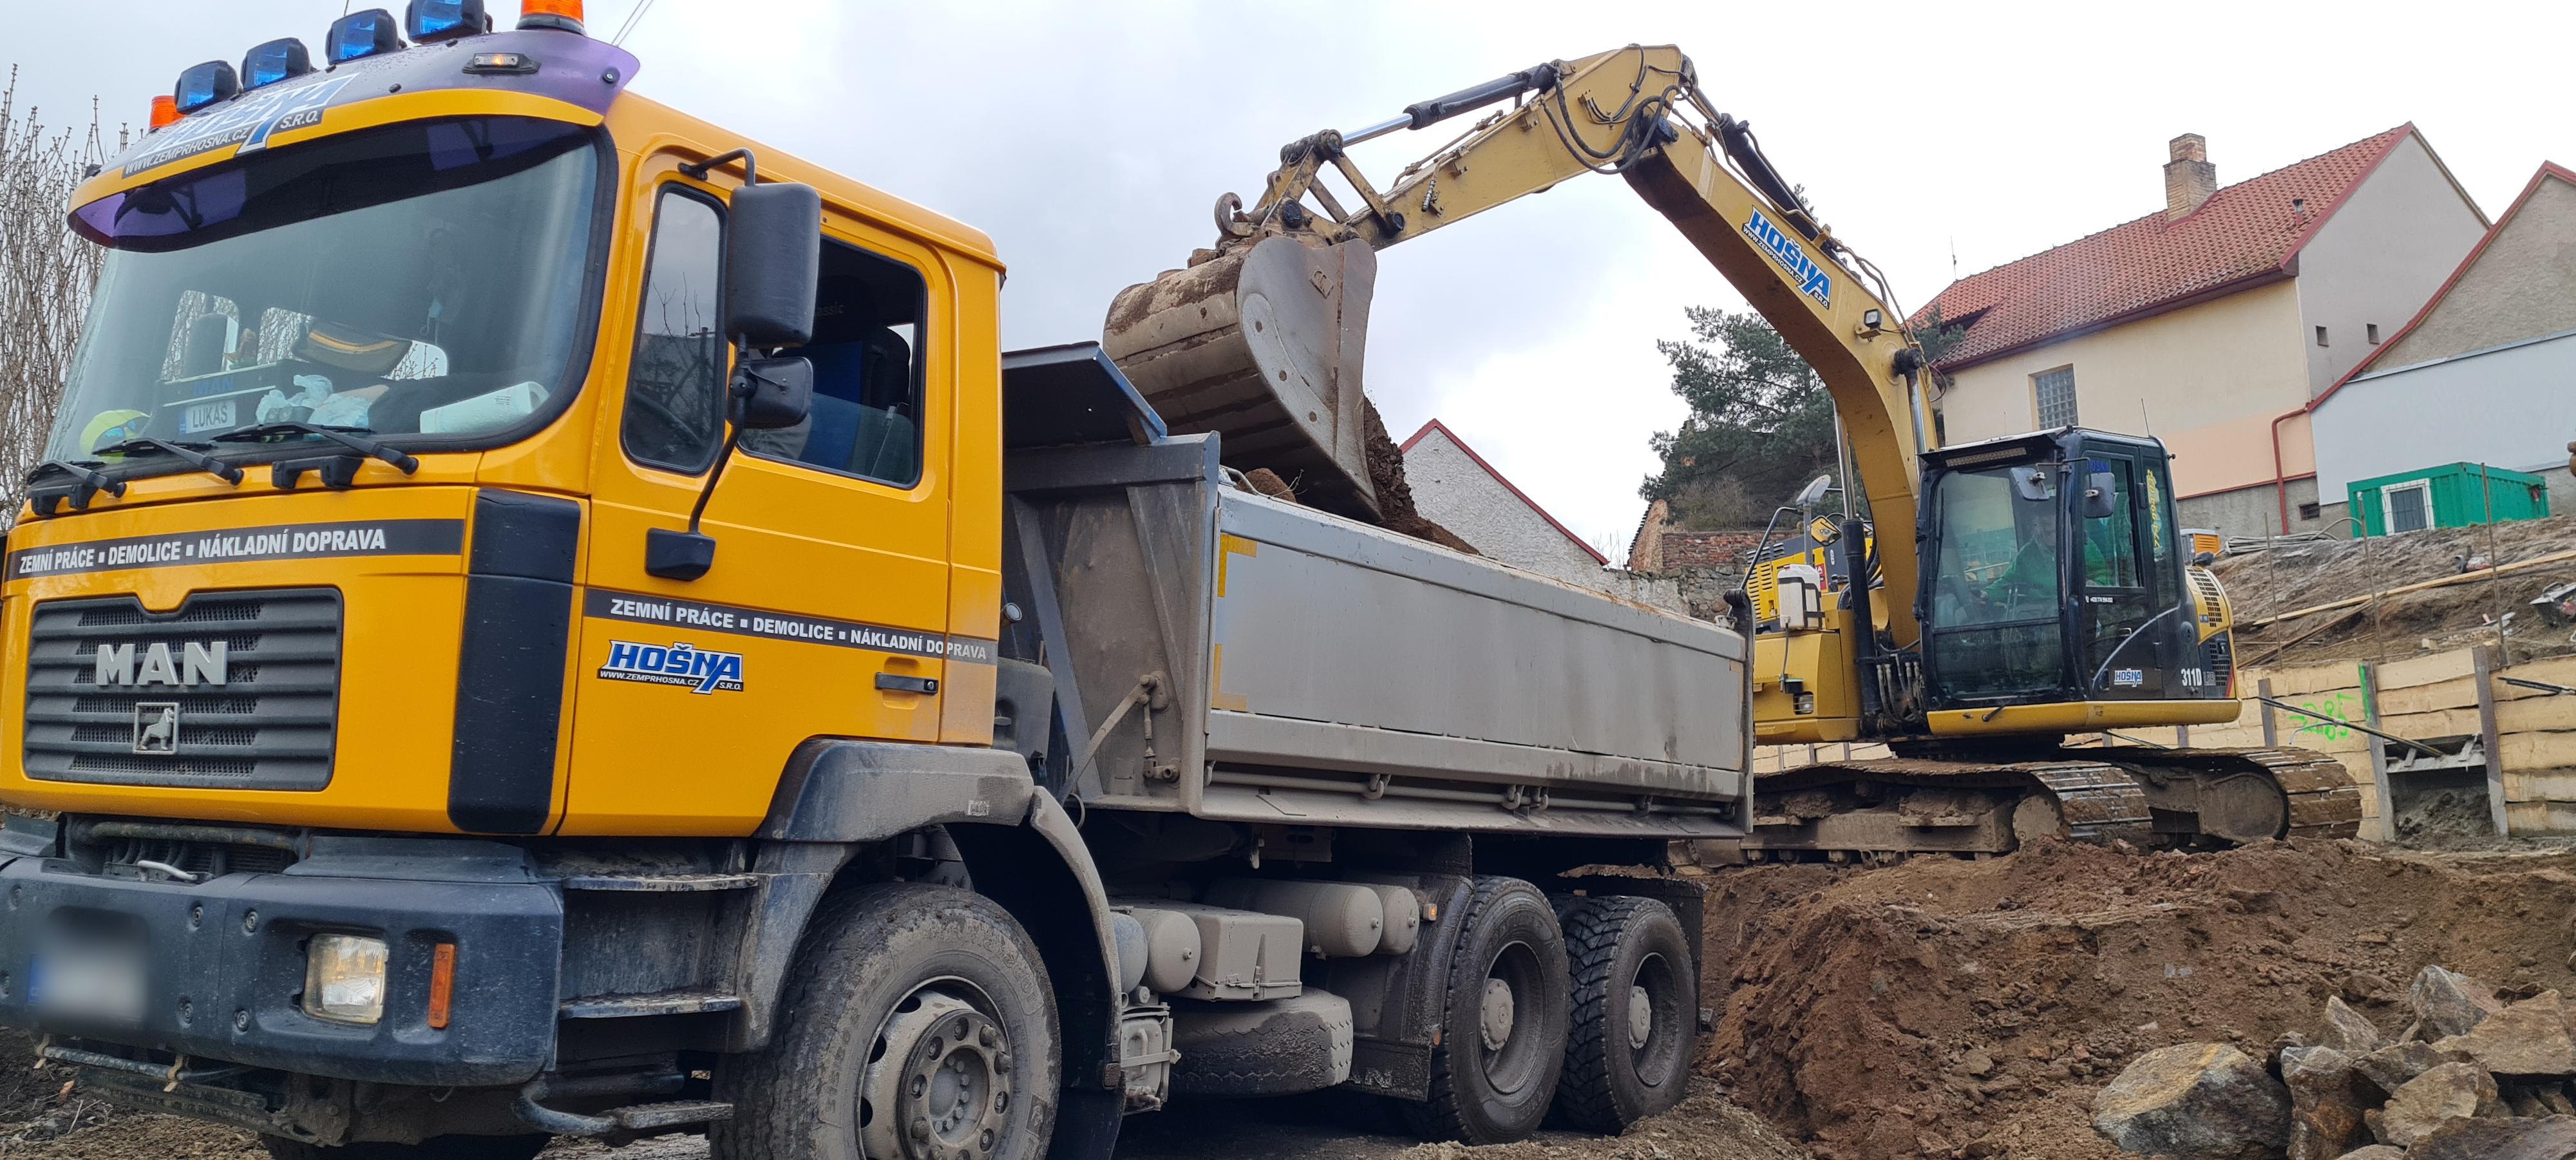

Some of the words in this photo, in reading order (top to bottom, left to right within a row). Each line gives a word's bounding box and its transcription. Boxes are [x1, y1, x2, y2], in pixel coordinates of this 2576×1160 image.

[279, 109, 319, 129] S.R.O.
[125, 128, 249, 175] WWW.ZEMPRHOSNA.CZ
[1743, 225, 1803, 283] WWW.ZEMPRHOSNA.CZ
[1748, 209, 1830, 299] HOŠNA
[817, 301, 844, 316] assic
[19, 548, 53, 574] ZEMNÍ
[55, 546, 95, 570] PRÁCE
[108, 541, 182, 566] DEMOLICE
[198, 528, 289, 558] NÁKLADNÍ
[292, 528, 386, 553] DOPRAVA
[611, 598, 670, 620] ZEMNÍ
[676, 607, 734, 629] PRÁCE
[753, 617, 834, 640] DEMOLICE
[850, 629, 922, 651] NÁKLADNÍ
[926, 640, 987, 660] DOPRAVA
[96, 641, 228, 685] MAN
[600, 670, 701, 686] WWW.ZEMPRHOSNA.CZ
[609, 642, 741, 692] HOŠNA
[2115, 668, 2143, 687] HOŠNA
[2181, 668, 2202, 687] 311D
[719, 682, 742, 690] S.R.O.
